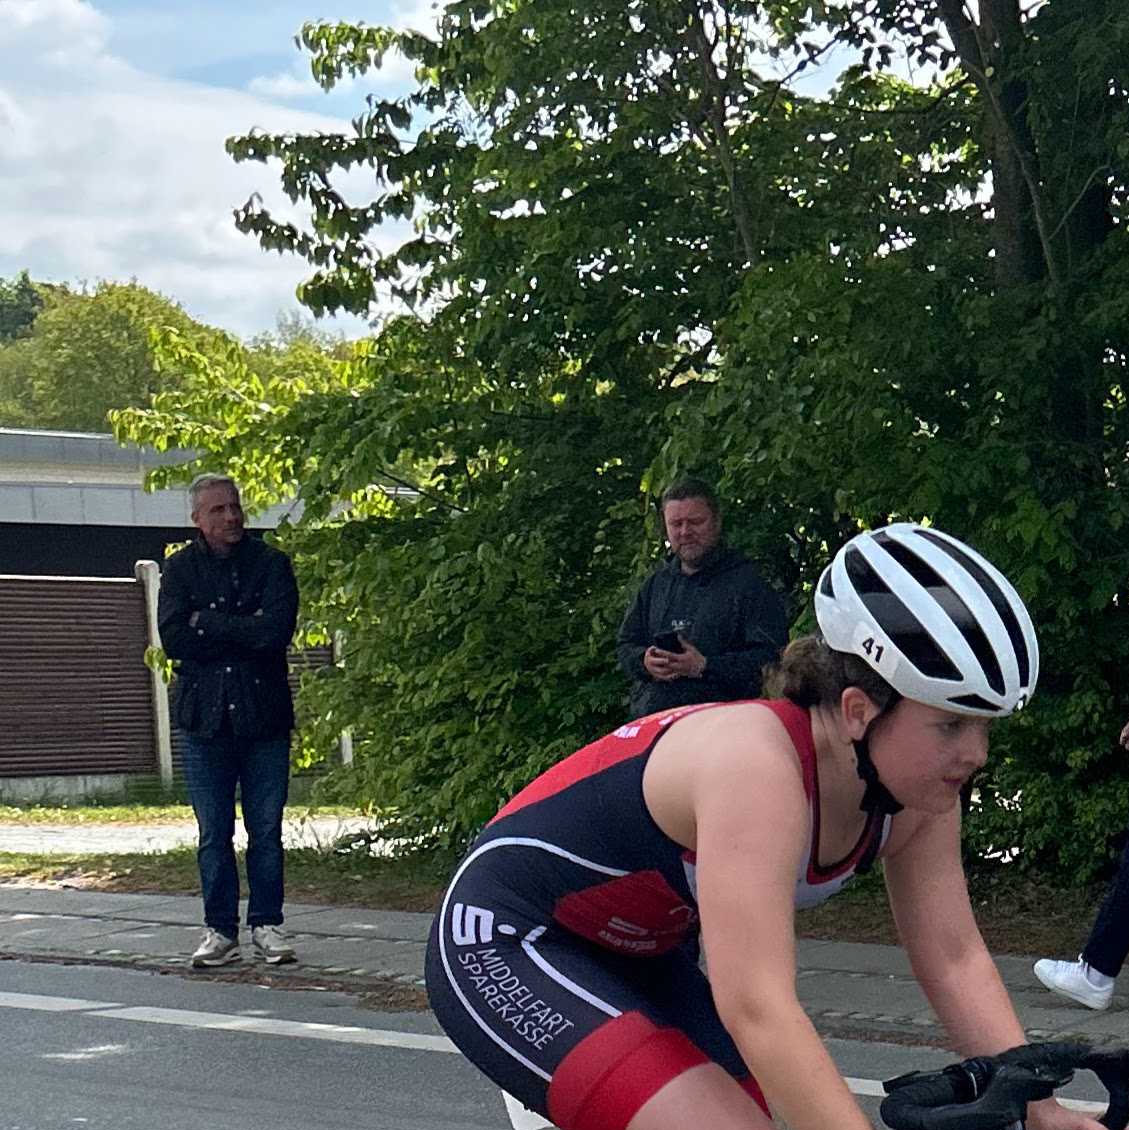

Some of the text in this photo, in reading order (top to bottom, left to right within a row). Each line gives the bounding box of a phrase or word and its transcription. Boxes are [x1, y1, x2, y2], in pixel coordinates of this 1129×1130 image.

[862, 637, 884, 663] 41
[458, 952, 554, 1051] SPAREKASSE
[477, 949, 575, 1036] MIDDELFART
